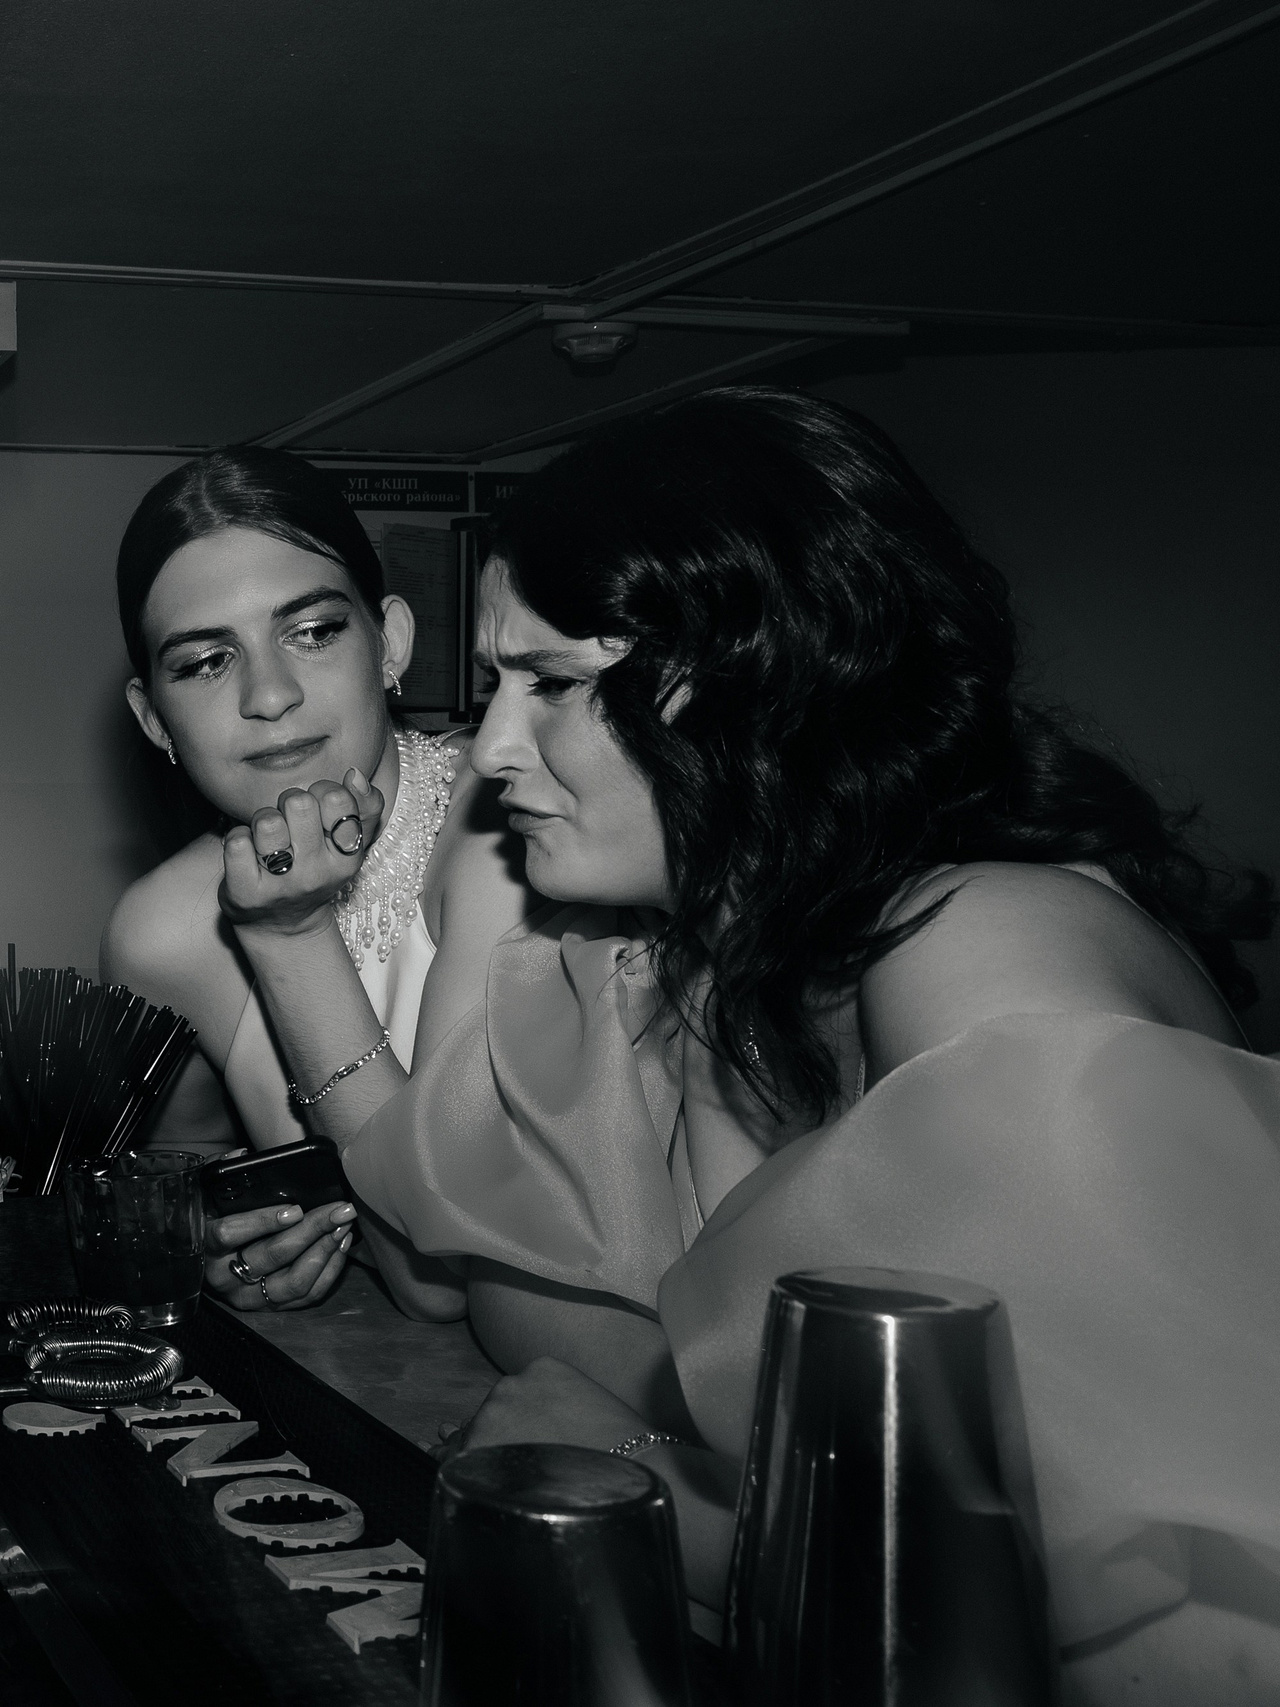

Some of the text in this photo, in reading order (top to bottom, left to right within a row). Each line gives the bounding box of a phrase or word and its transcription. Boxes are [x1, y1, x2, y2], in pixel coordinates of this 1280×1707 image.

[348, 477, 418, 490] УП «КШП
[406, 490, 461, 504] района»
